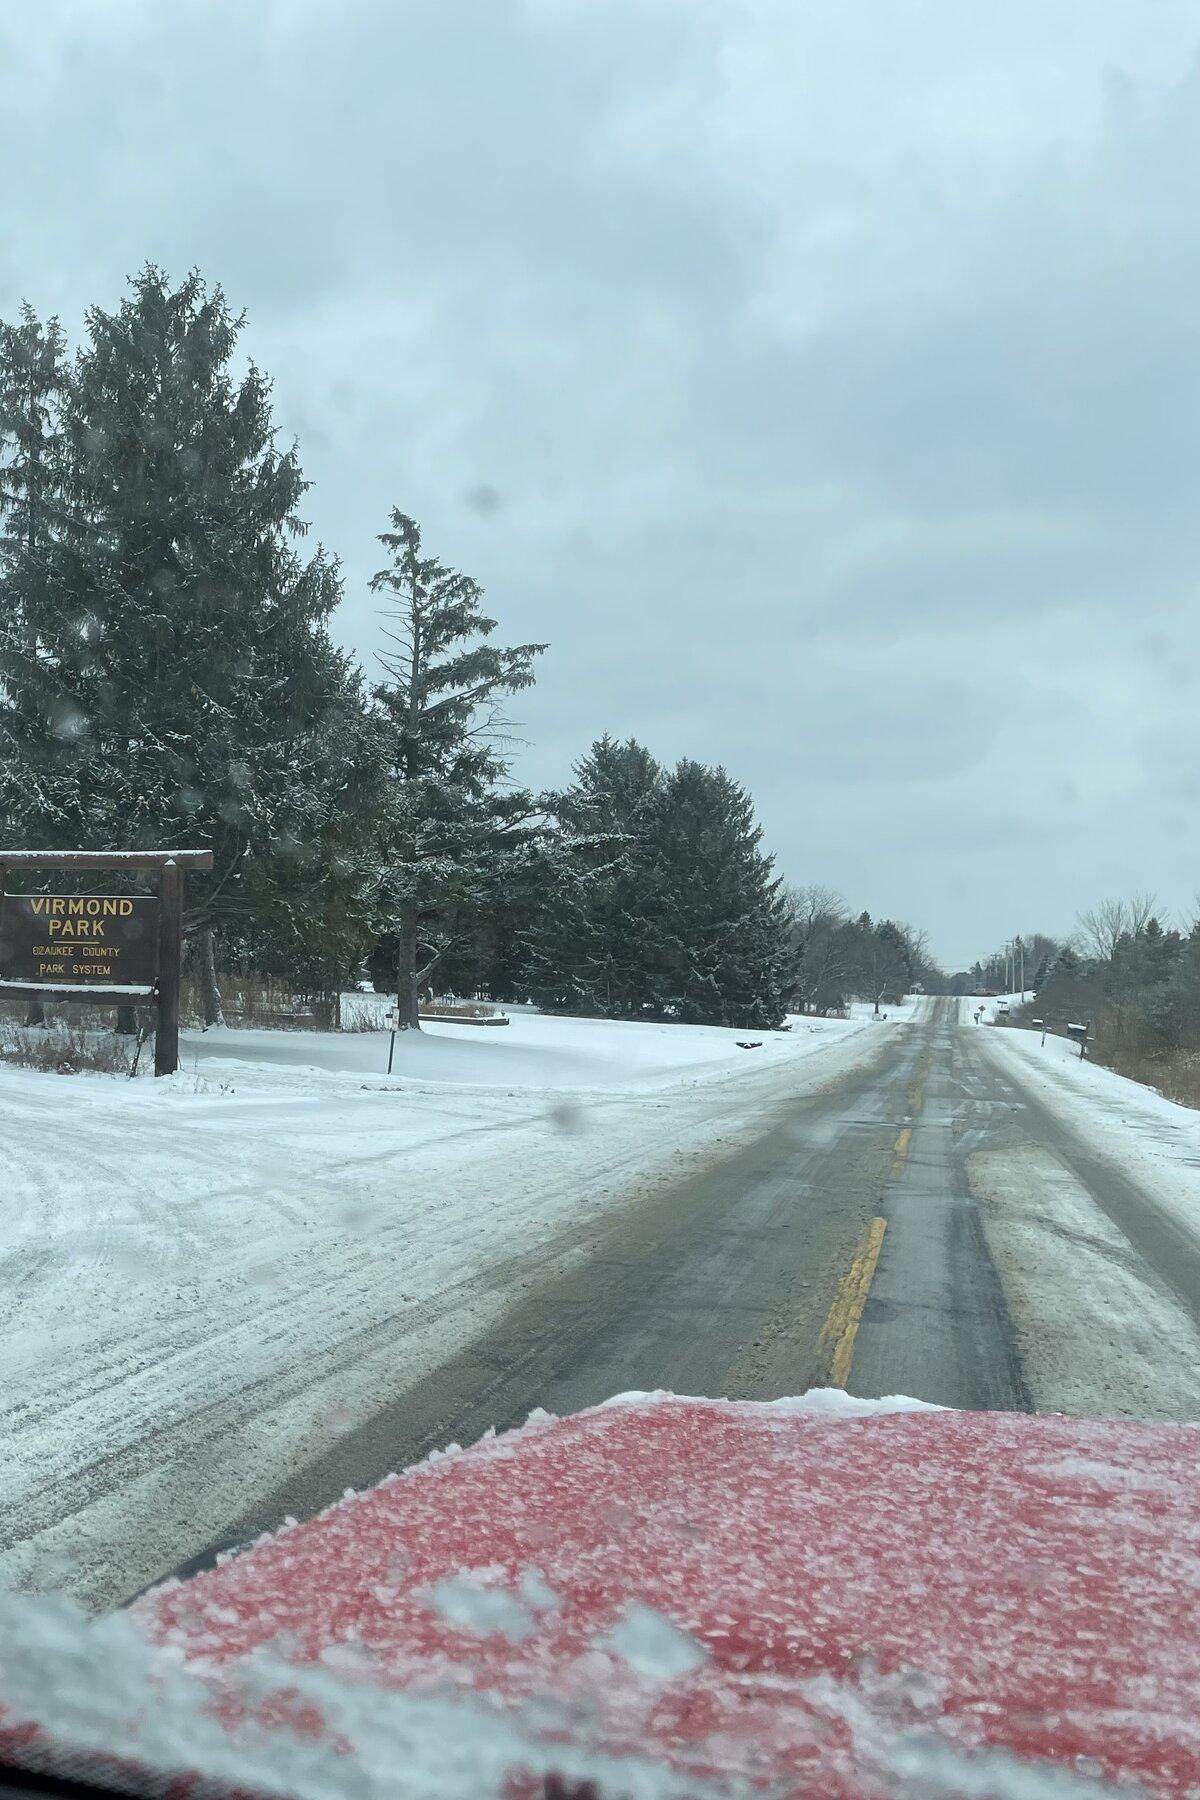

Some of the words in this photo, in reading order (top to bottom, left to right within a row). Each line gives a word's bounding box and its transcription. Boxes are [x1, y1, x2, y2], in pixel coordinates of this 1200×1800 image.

[30, 898, 132, 915] VIRMOND
[49, 919, 105, 936] PARK
[32, 946, 74, 956] OZAUKEE
[82, 947, 120, 957] COUNTY
[39, 963, 64, 973] PARK
[72, 964, 111, 975] SYSTEM
